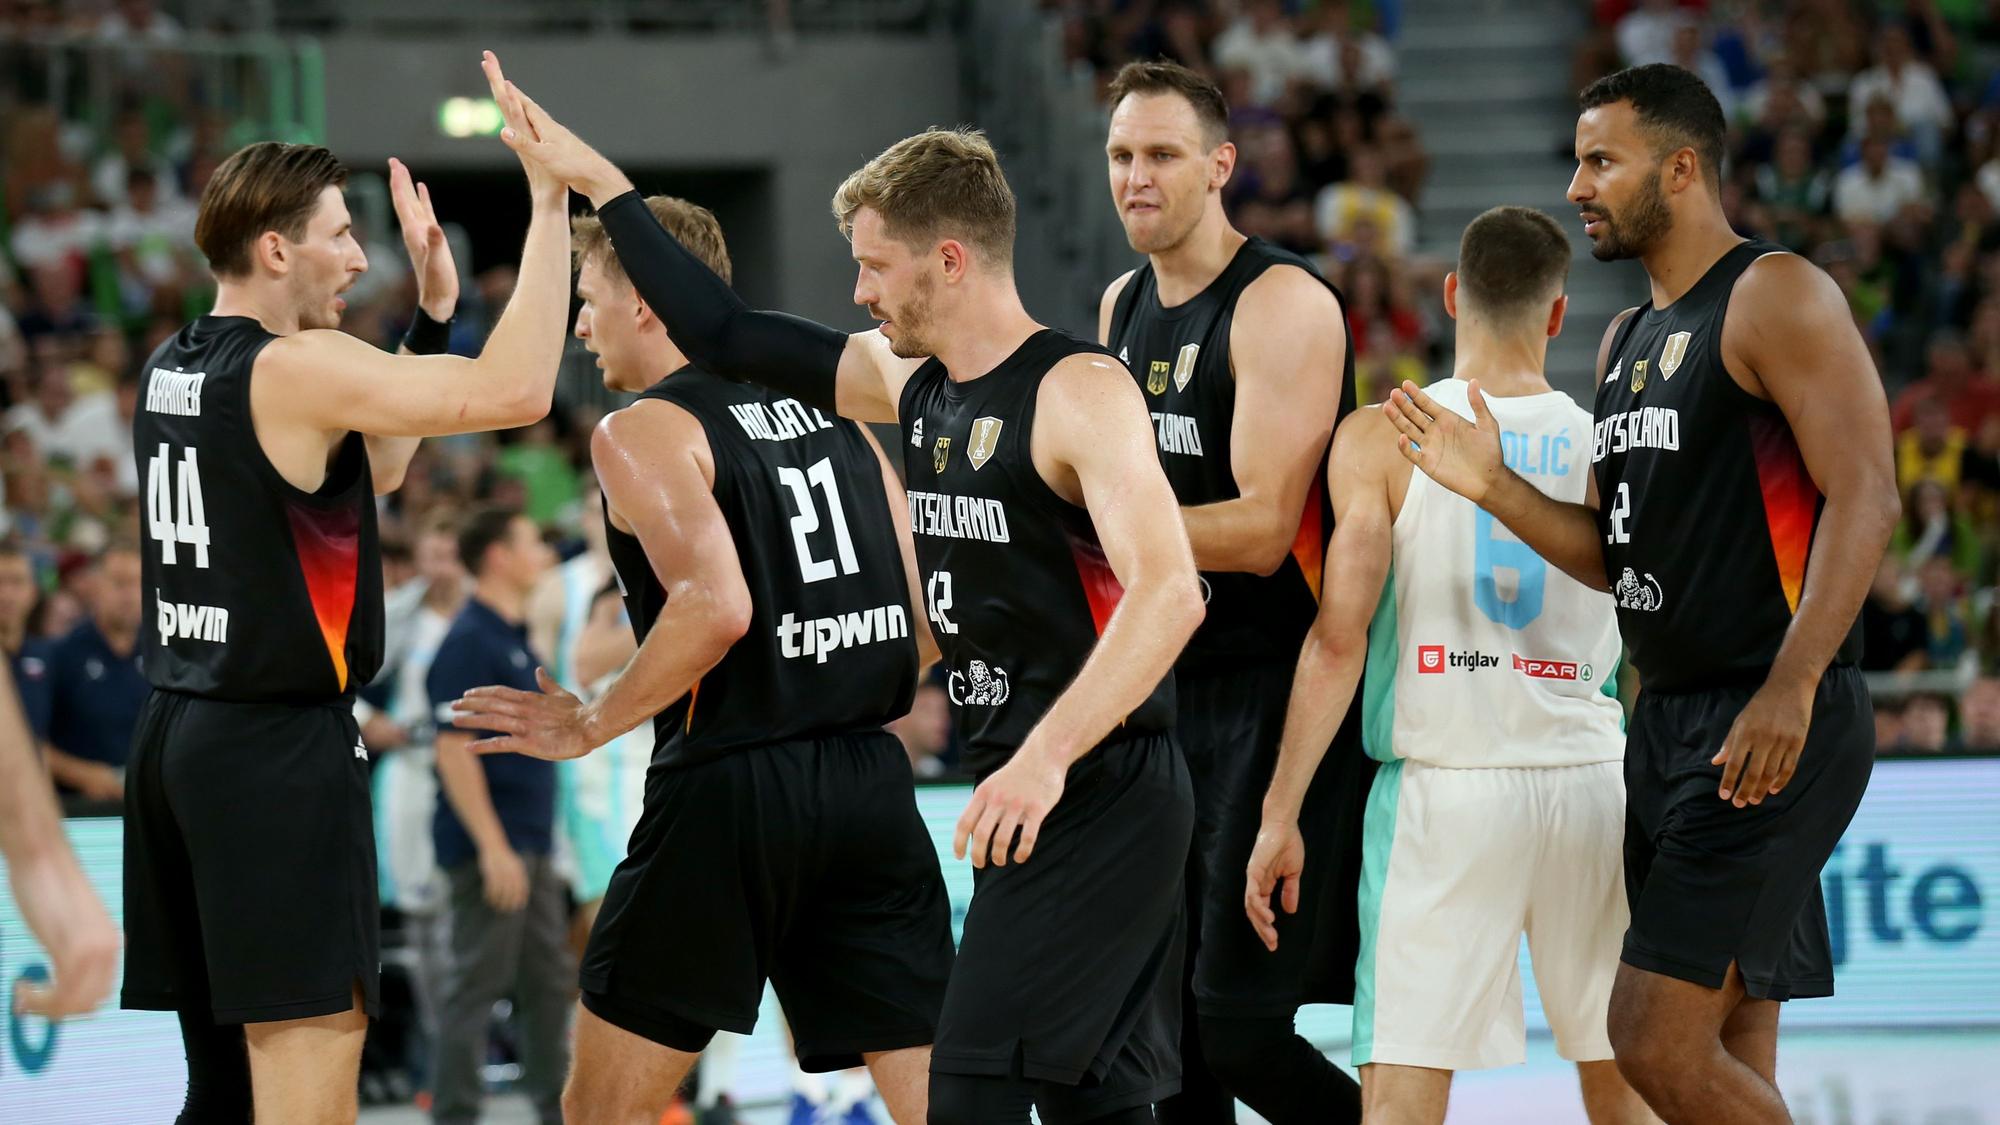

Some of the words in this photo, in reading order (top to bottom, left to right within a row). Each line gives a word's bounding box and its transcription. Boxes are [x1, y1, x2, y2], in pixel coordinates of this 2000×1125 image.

[1501, 427, 1571, 477] OLIĆ
[148, 442, 210, 568] 44
[777, 456, 860, 584] 21
[927, 570, 958, 634] 42
[777, 604, 908, 664] tipwin
[1449, 650, 1500, 672] triglav
[1516, 659, 1577, 678] SPAR
